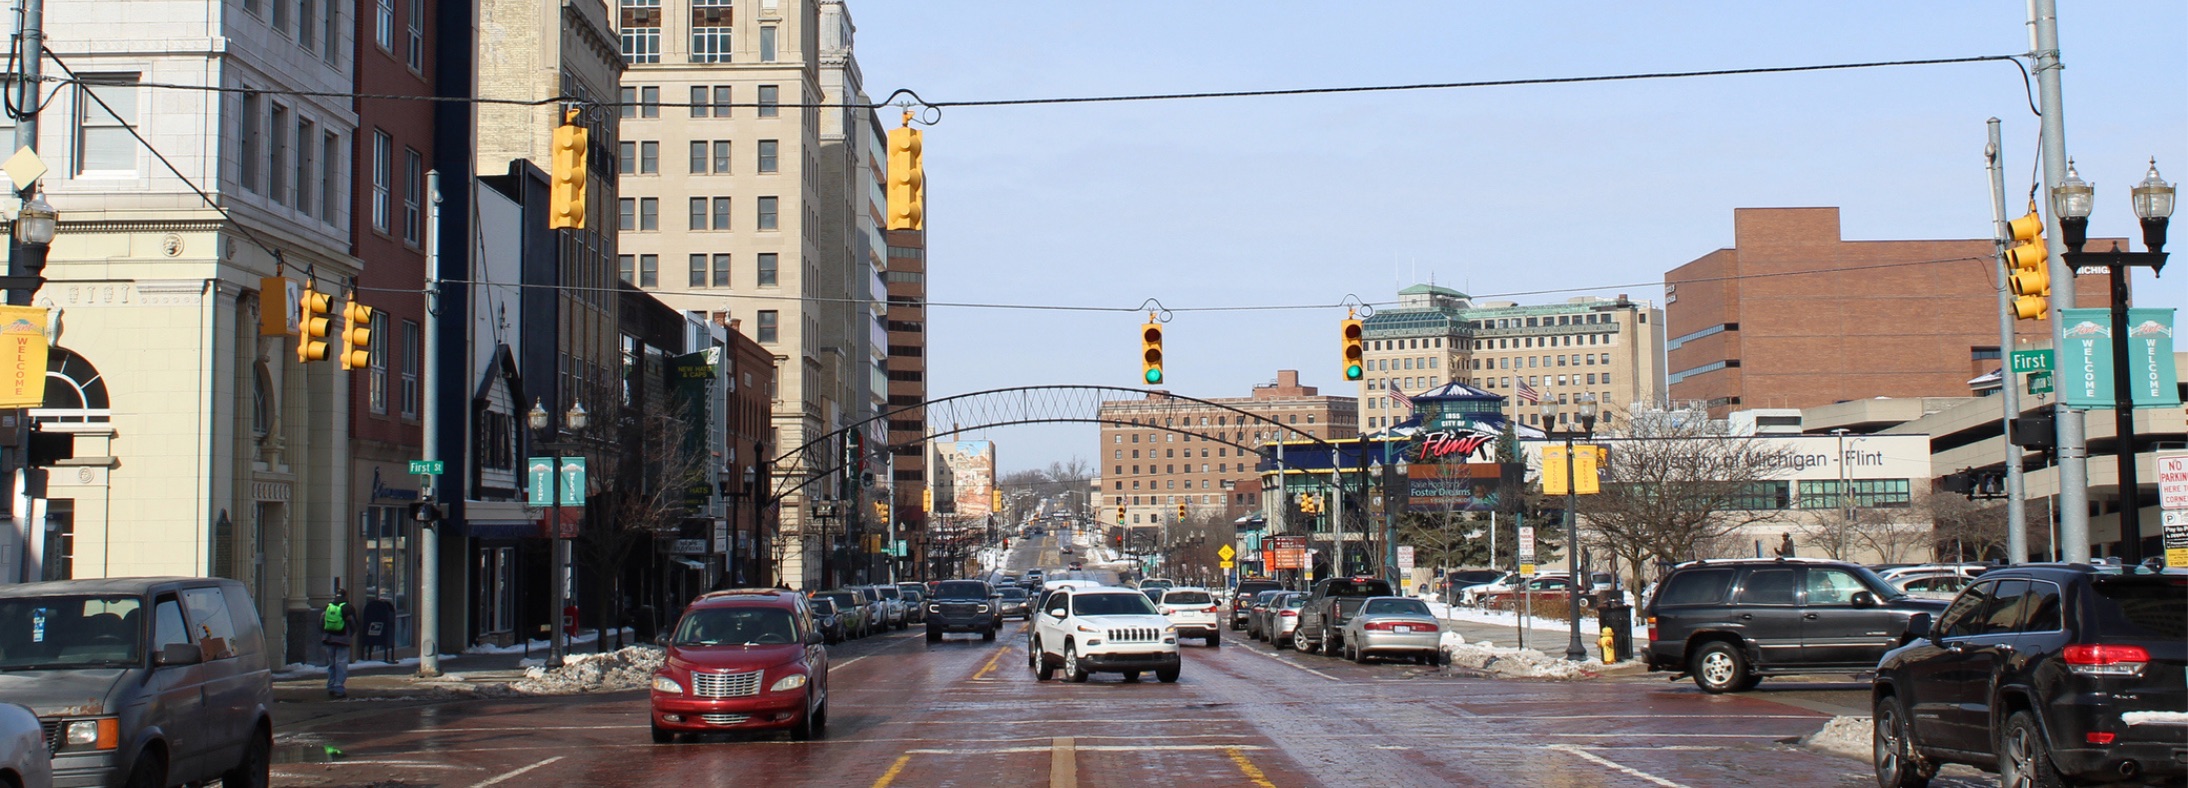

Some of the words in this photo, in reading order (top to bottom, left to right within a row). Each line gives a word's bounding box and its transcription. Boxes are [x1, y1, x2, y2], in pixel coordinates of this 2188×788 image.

[15, 337, 28, 396] WELCOME
[2014, 354, 2046, 369] First
[2082, 339, 2095, 397] WELCOME
[2146, 338, 2159, 397] WELCOME
[1420, 431, 1497, 460] Flint
[410, 462, 430, 473] First
[434, 463, 442, 472] St
[1724, 453, 1741, 467] of
[1747, 452, 1826, 471] Michigan
[1845, 451, 1883, 466] Flint
[2168, 461, 2182, 471] NO
[2161, 472, 2188, 483] PARKIN
[1411, 488, 1436, 497] Foster
[1438, 488, 1471, 497] Dreams
[2163, 484, 2181, 493] HERE
[2165, 495, 2188, 504] CORNE
